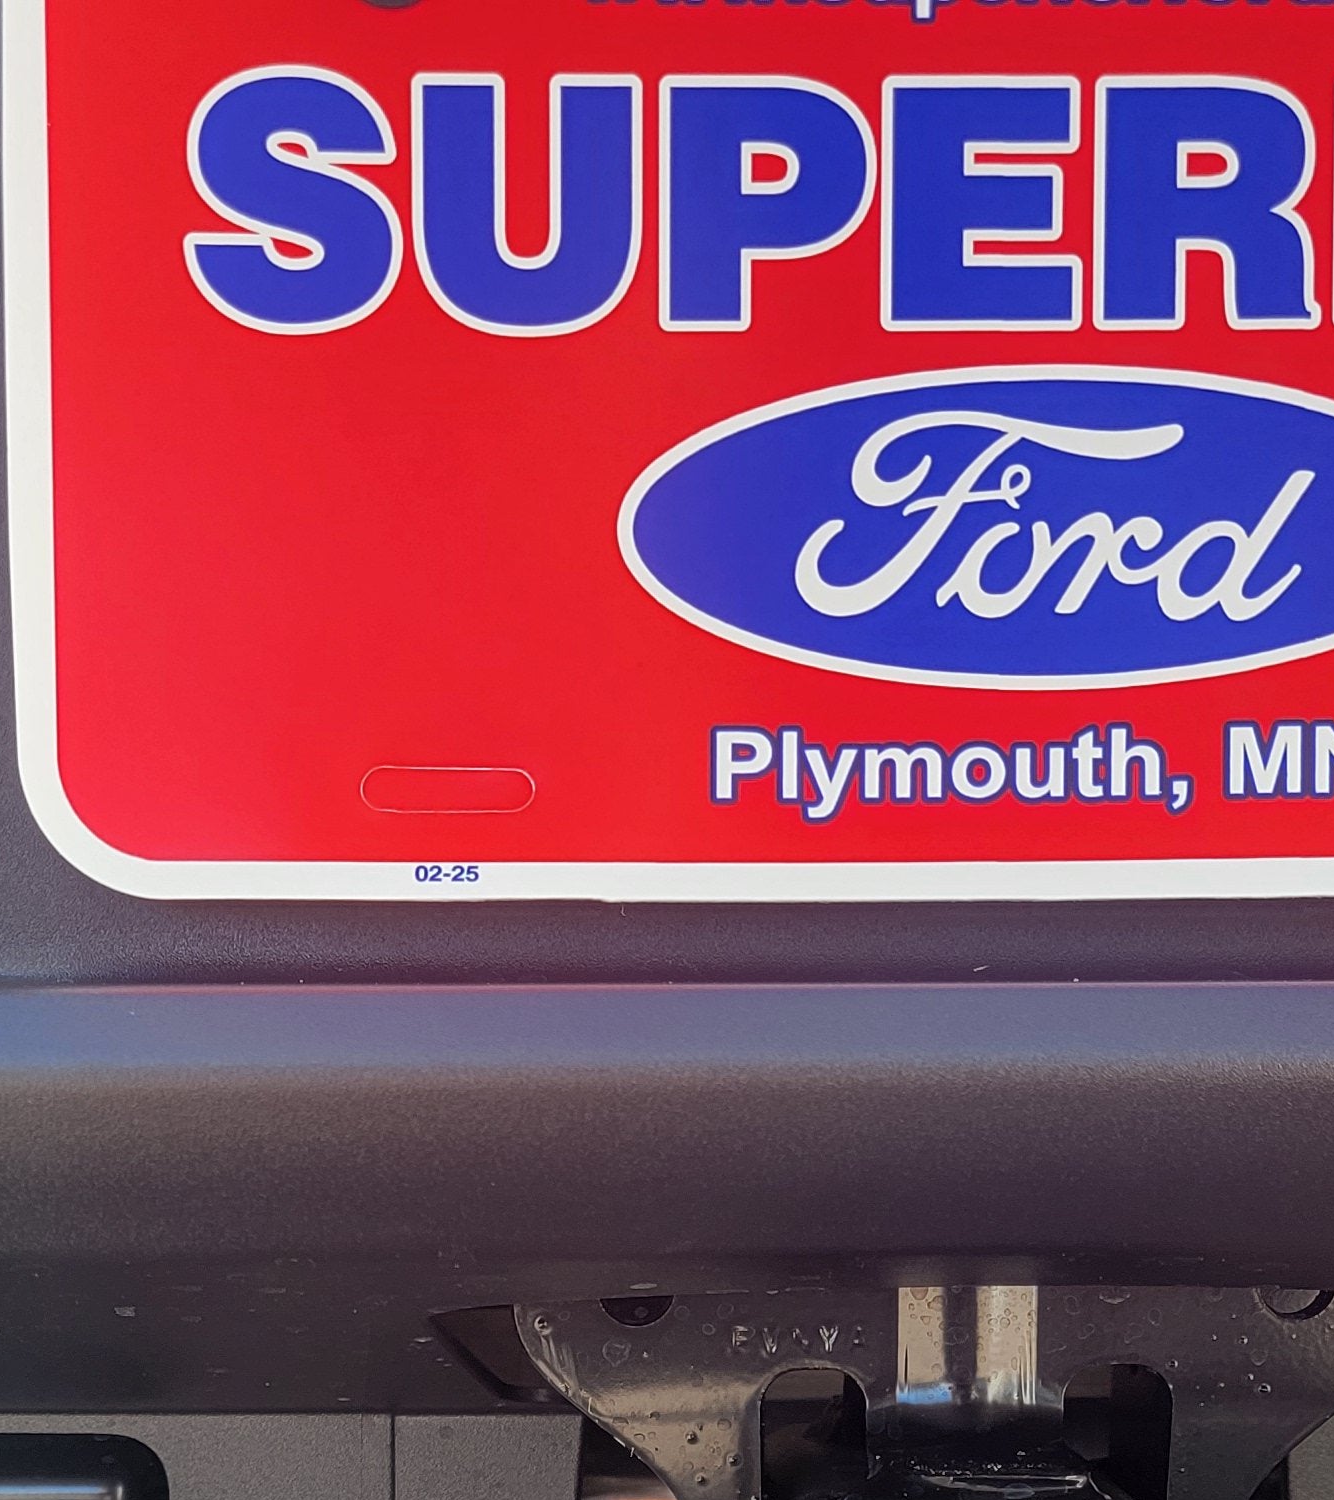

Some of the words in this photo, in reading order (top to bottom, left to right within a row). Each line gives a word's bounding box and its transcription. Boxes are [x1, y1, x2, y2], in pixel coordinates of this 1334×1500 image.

[794, 411, 1315, 621] Ford
[711, 724, 1194, 820] Plymouth,
[414, 865, 479, 882] 02-25
